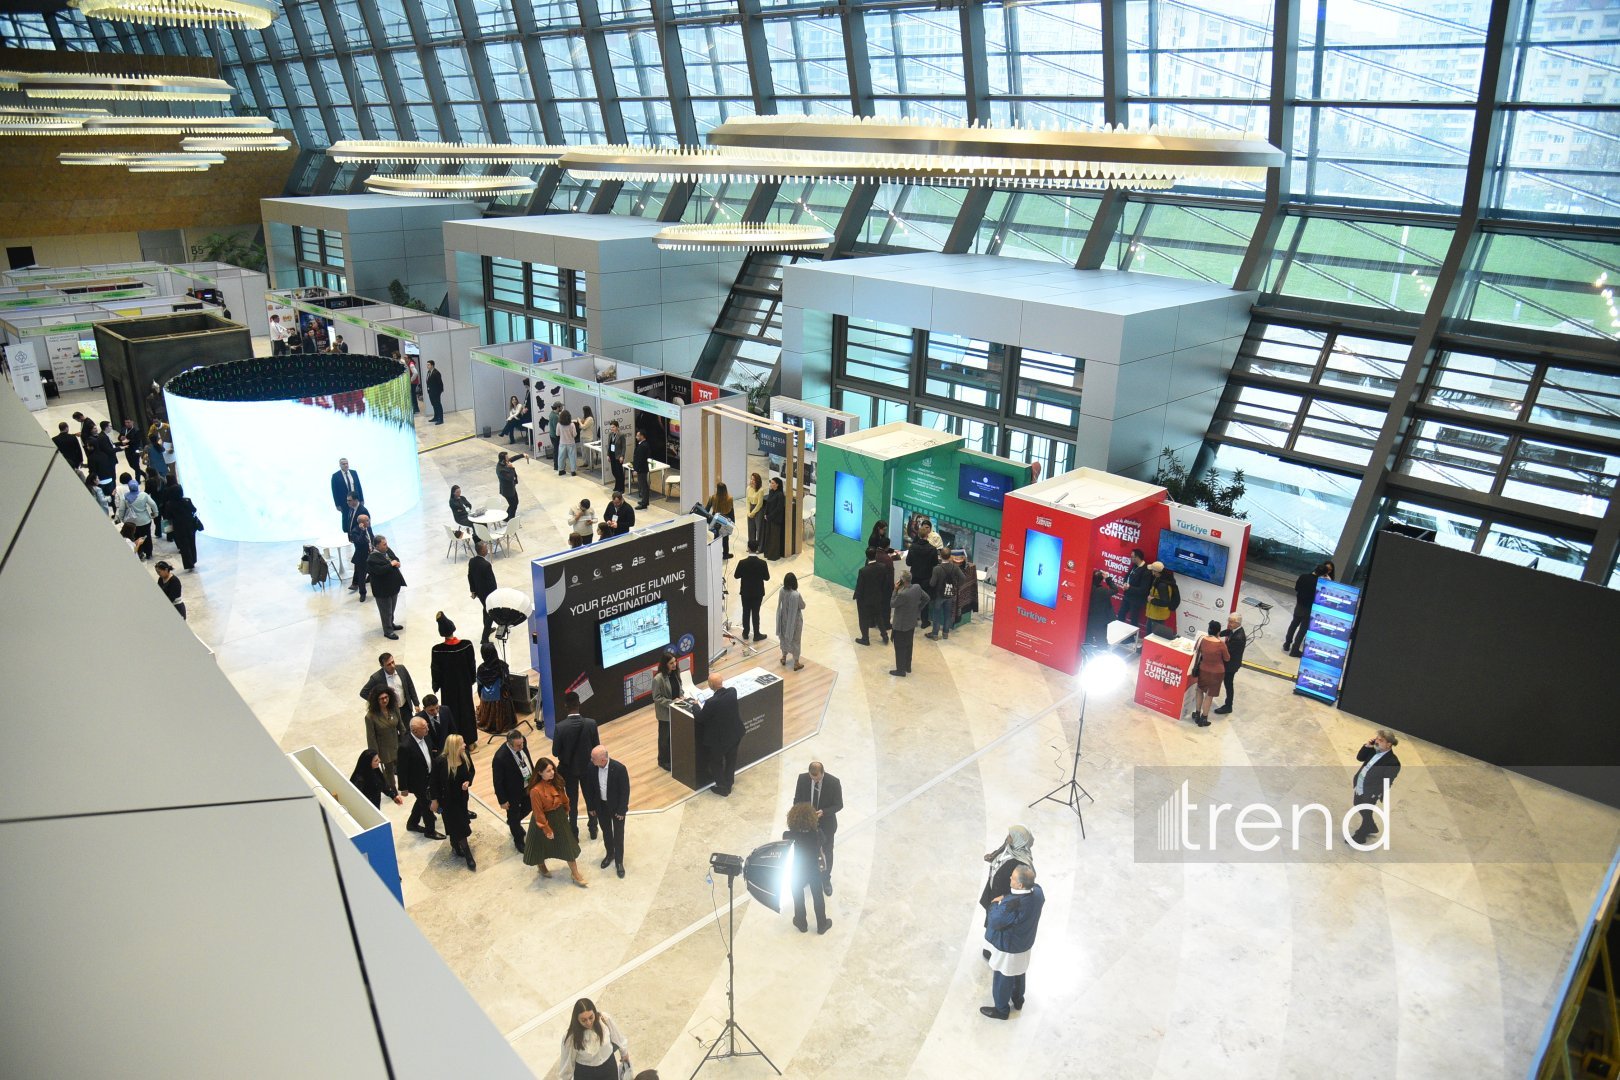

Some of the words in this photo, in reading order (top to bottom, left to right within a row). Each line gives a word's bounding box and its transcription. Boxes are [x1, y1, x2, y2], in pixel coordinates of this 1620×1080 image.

[698, 389, 713, 400] TRT
[760, 440, 776, 448] CENTER
[1099, 526, 1140, 544] CONTENT
[1106, 521, 1140, 537] URKISH
[1176, 519, 1208, 535] Türkiye
[569, 600, 599, 616] YOUR
[601, 582, 646, 608] FAVORITE
[648, 570, 686, 588] FILMING
[598, 590, 661, 620] DESTINATION
[1016, 606, 1047, 624] Türkiye
[1144, 669, 1181, 688] CONTENT
[1145, 662, 1182, 682] TURKISH
